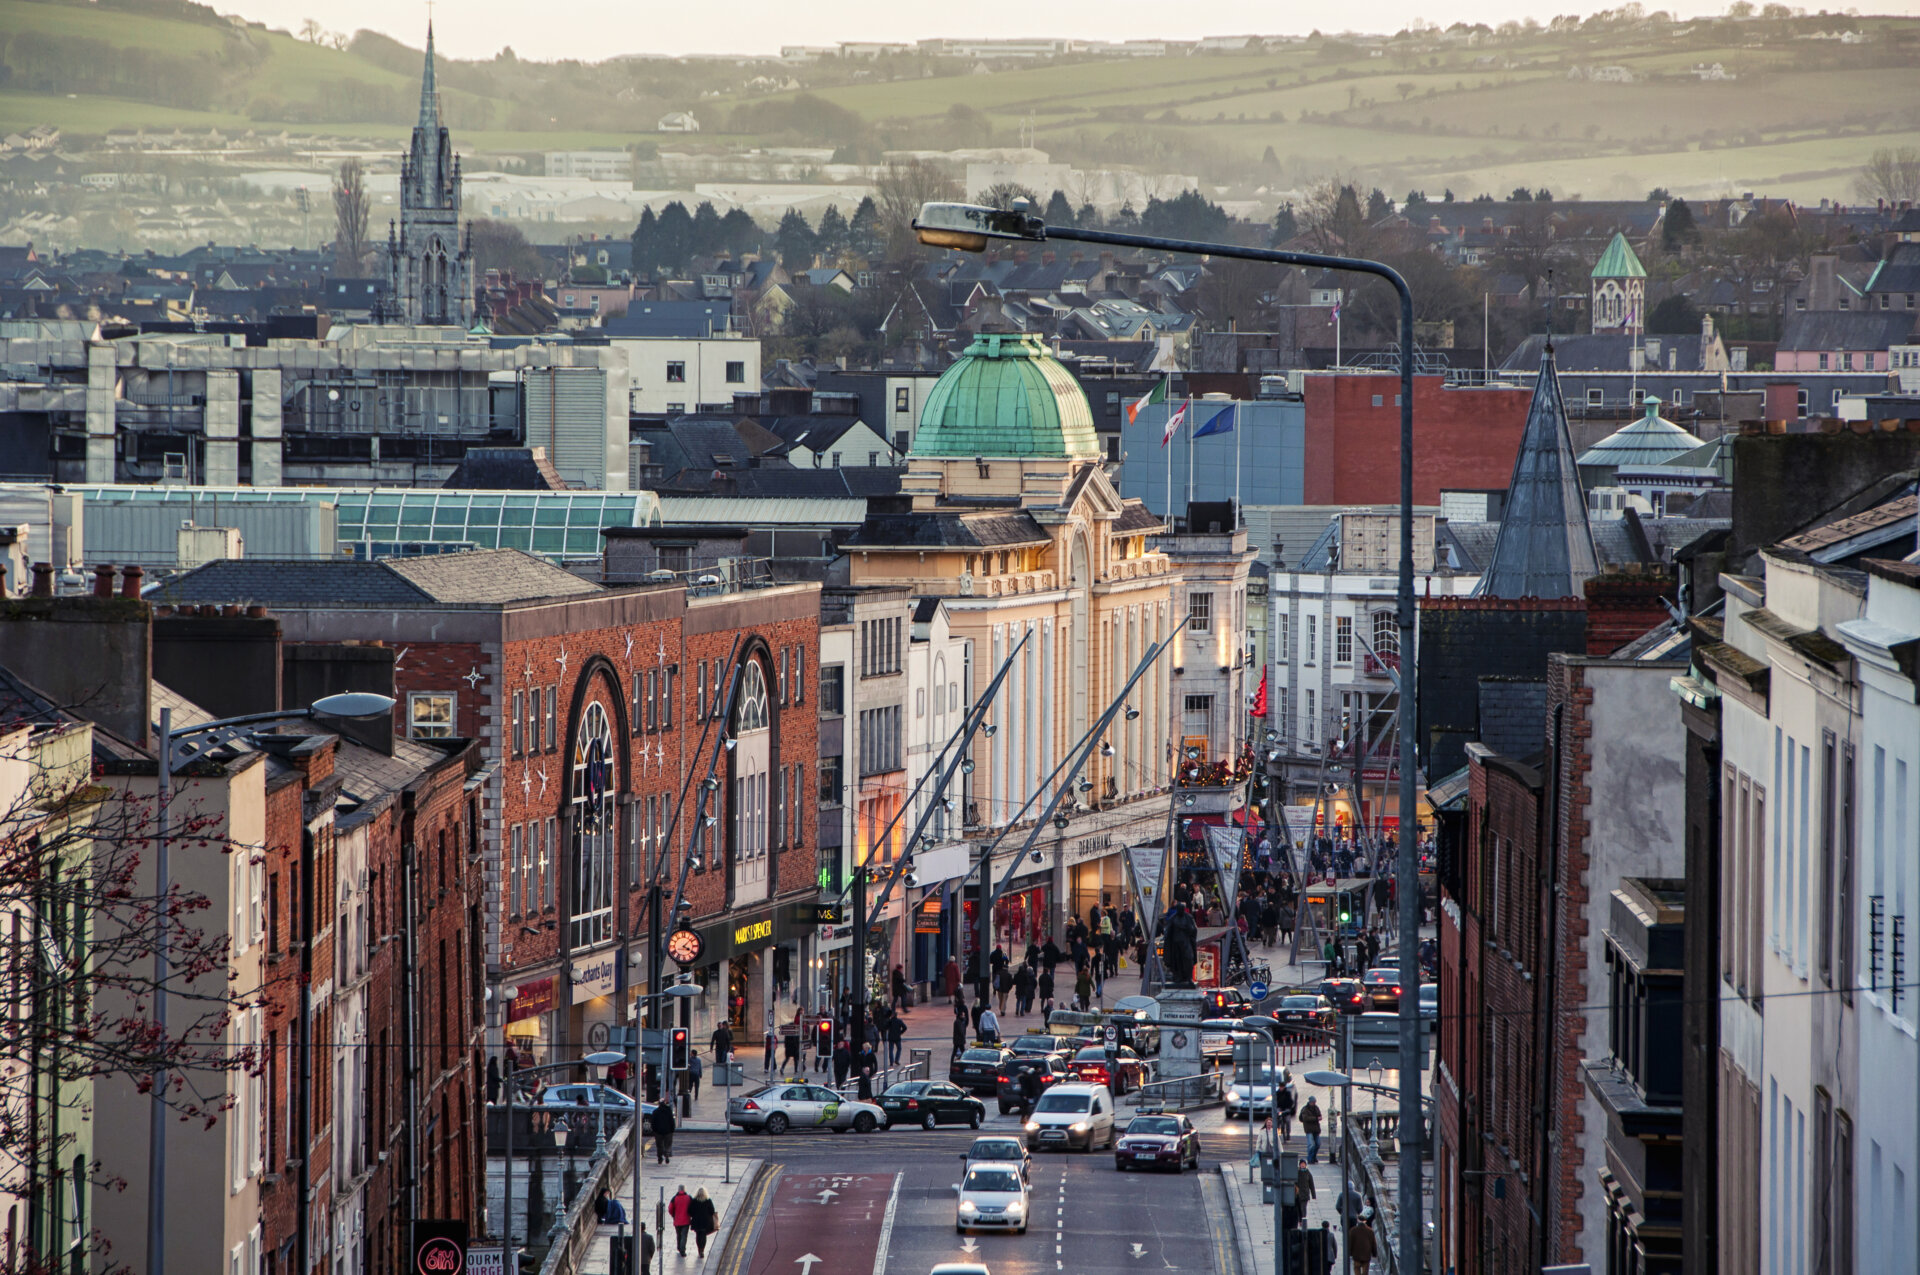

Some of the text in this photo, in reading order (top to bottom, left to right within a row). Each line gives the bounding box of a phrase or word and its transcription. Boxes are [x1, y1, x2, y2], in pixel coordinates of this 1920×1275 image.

[1079, 833, 1112, 856] DEBENHAMS
[735, 925, 750, 945] MARKS
[753, 919, 772, 941] SPENCER
[600, 961, 612, 982] Quay
